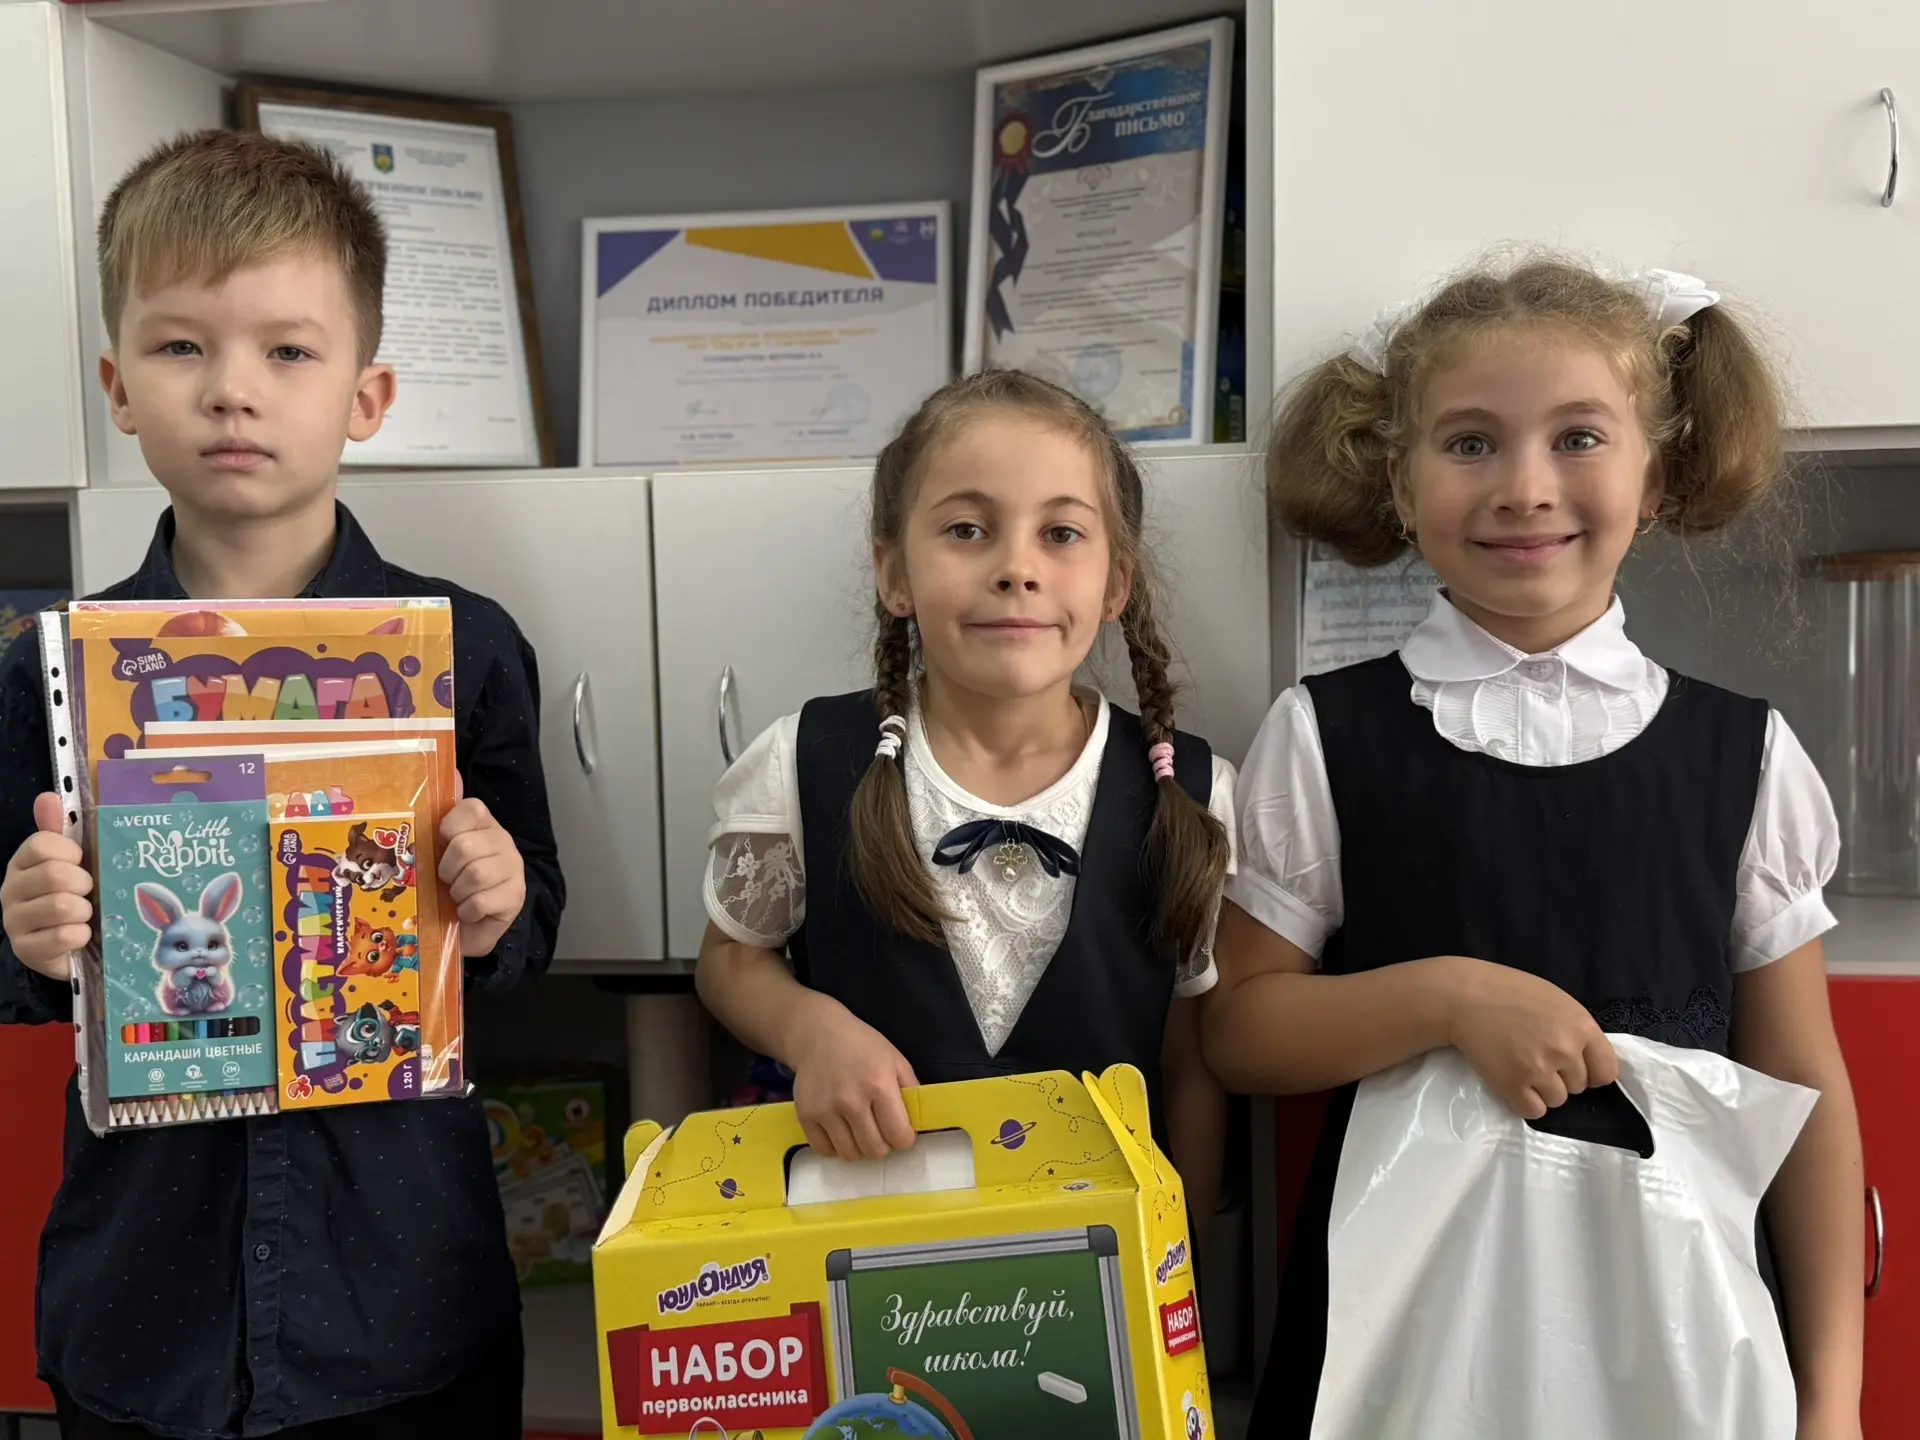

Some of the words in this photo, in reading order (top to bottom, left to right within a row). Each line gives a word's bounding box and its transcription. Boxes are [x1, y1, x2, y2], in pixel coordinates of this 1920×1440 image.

[1031, 91, 1201, 158] Благодарственное
[1114, 111, 1186, 138] ПИСЬМО
[647, 292, 737, 314] ДИПЛОМ
[744, 286, 885, 309] ПОБЕДИТЕЛЯ
[137, 652, 164, 665] SIMA
[139, 660, 167, 673] LAND
[150, 672, 392, 722] БУМАГА
[238, 762, 255, 775] 12
[184, 816, 232, 839] Little
[374, 830, 398, 849] 6
[396, 824, 409, 856] ЦВЕТОВ
[137, 832, 236, 878] Rabbit
[289, 833, 297, 853] LAND
[332, 886, 345, 954] КЛАССИЧЕСКИЙ
[296, 865, 337, 1071] ПЛАСТИЛИН
[124, 1048, 201, 1063] КАРАНДАШИ
[205, 1043, 263, 1059] ЦВЕТНЫЕ
[403, 1071, 413, 1089] 120
[880, 1287, 1075, 1346] Здравствуй,
[1167, 1306, 1194, 1333] НАБОР
[650, 1336, 804, 1387] НАБОР
[923, 1341, 1031, 1373] школа!
[642, 1388, 808, 1417] первоклассника
